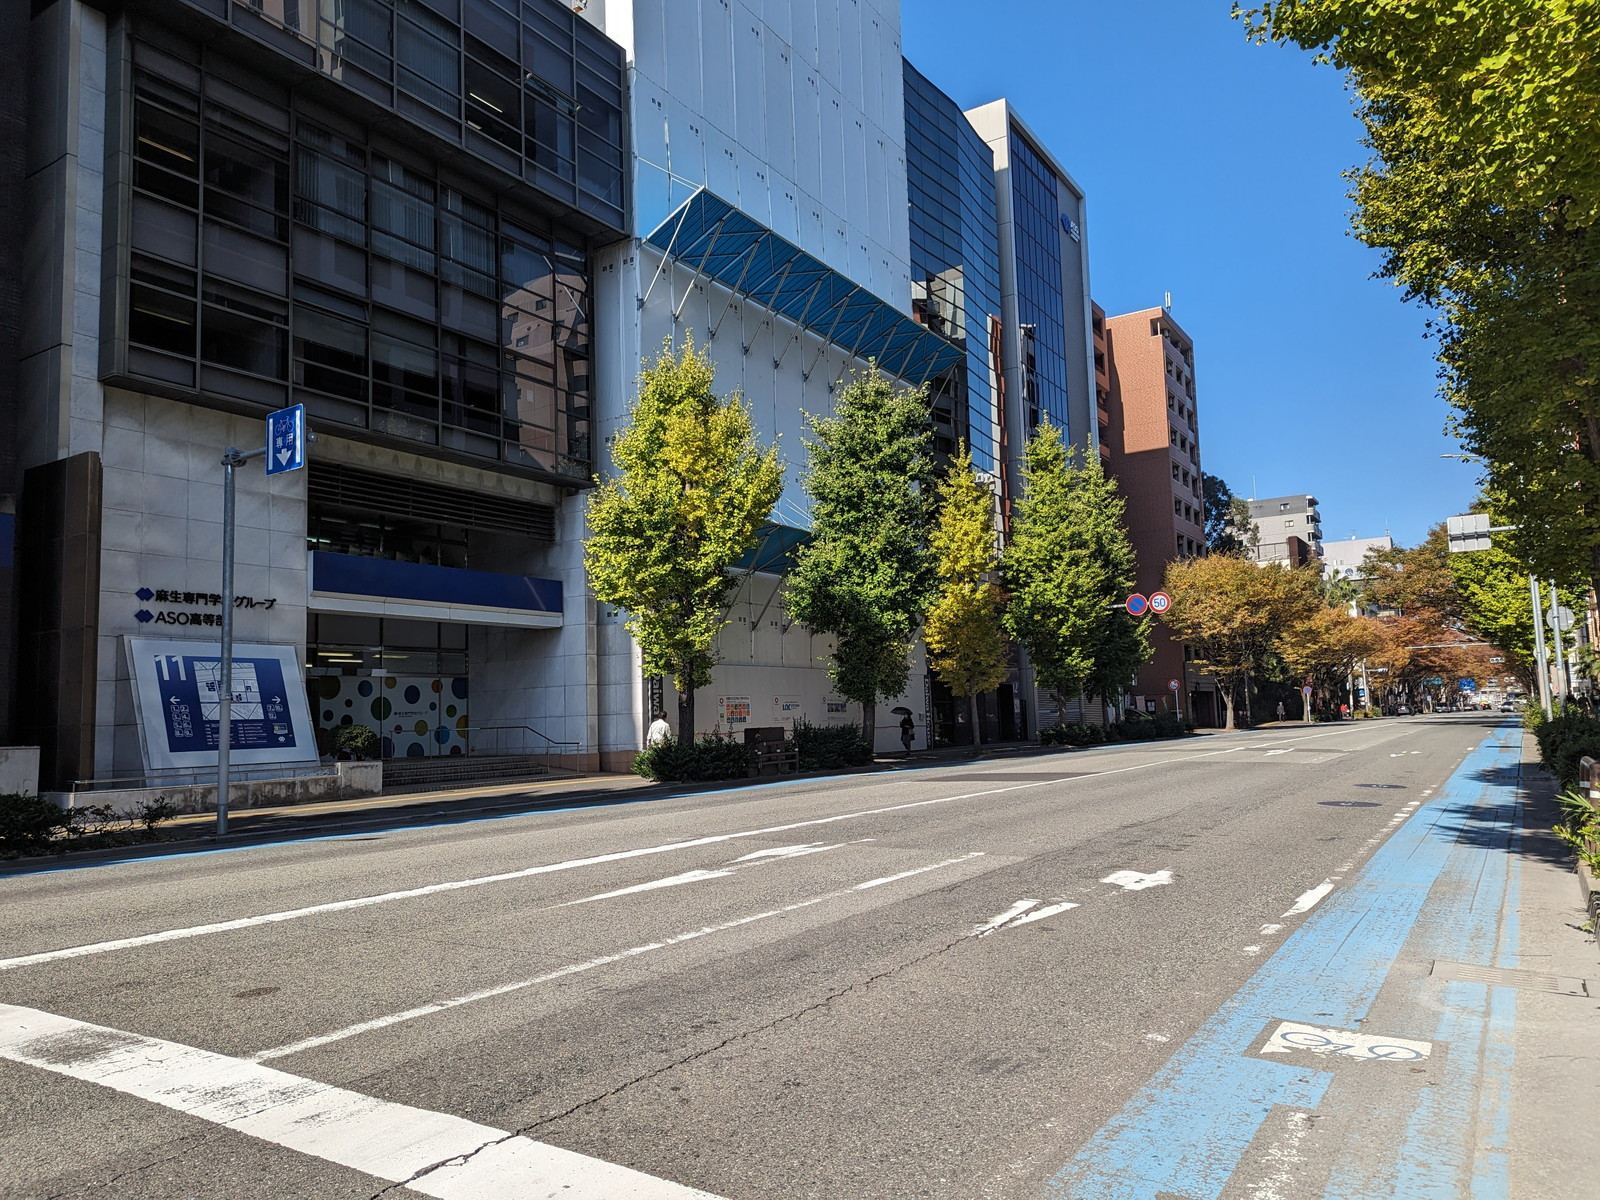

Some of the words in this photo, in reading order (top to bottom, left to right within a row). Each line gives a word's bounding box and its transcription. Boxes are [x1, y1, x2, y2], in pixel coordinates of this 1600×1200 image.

[276, 432, 294, 448] 専用
[155, 589, 277, 610] 麻生専門学グループ
[1154, 598, 1166, 608] 50
[155, 655, 187, 681] 11
